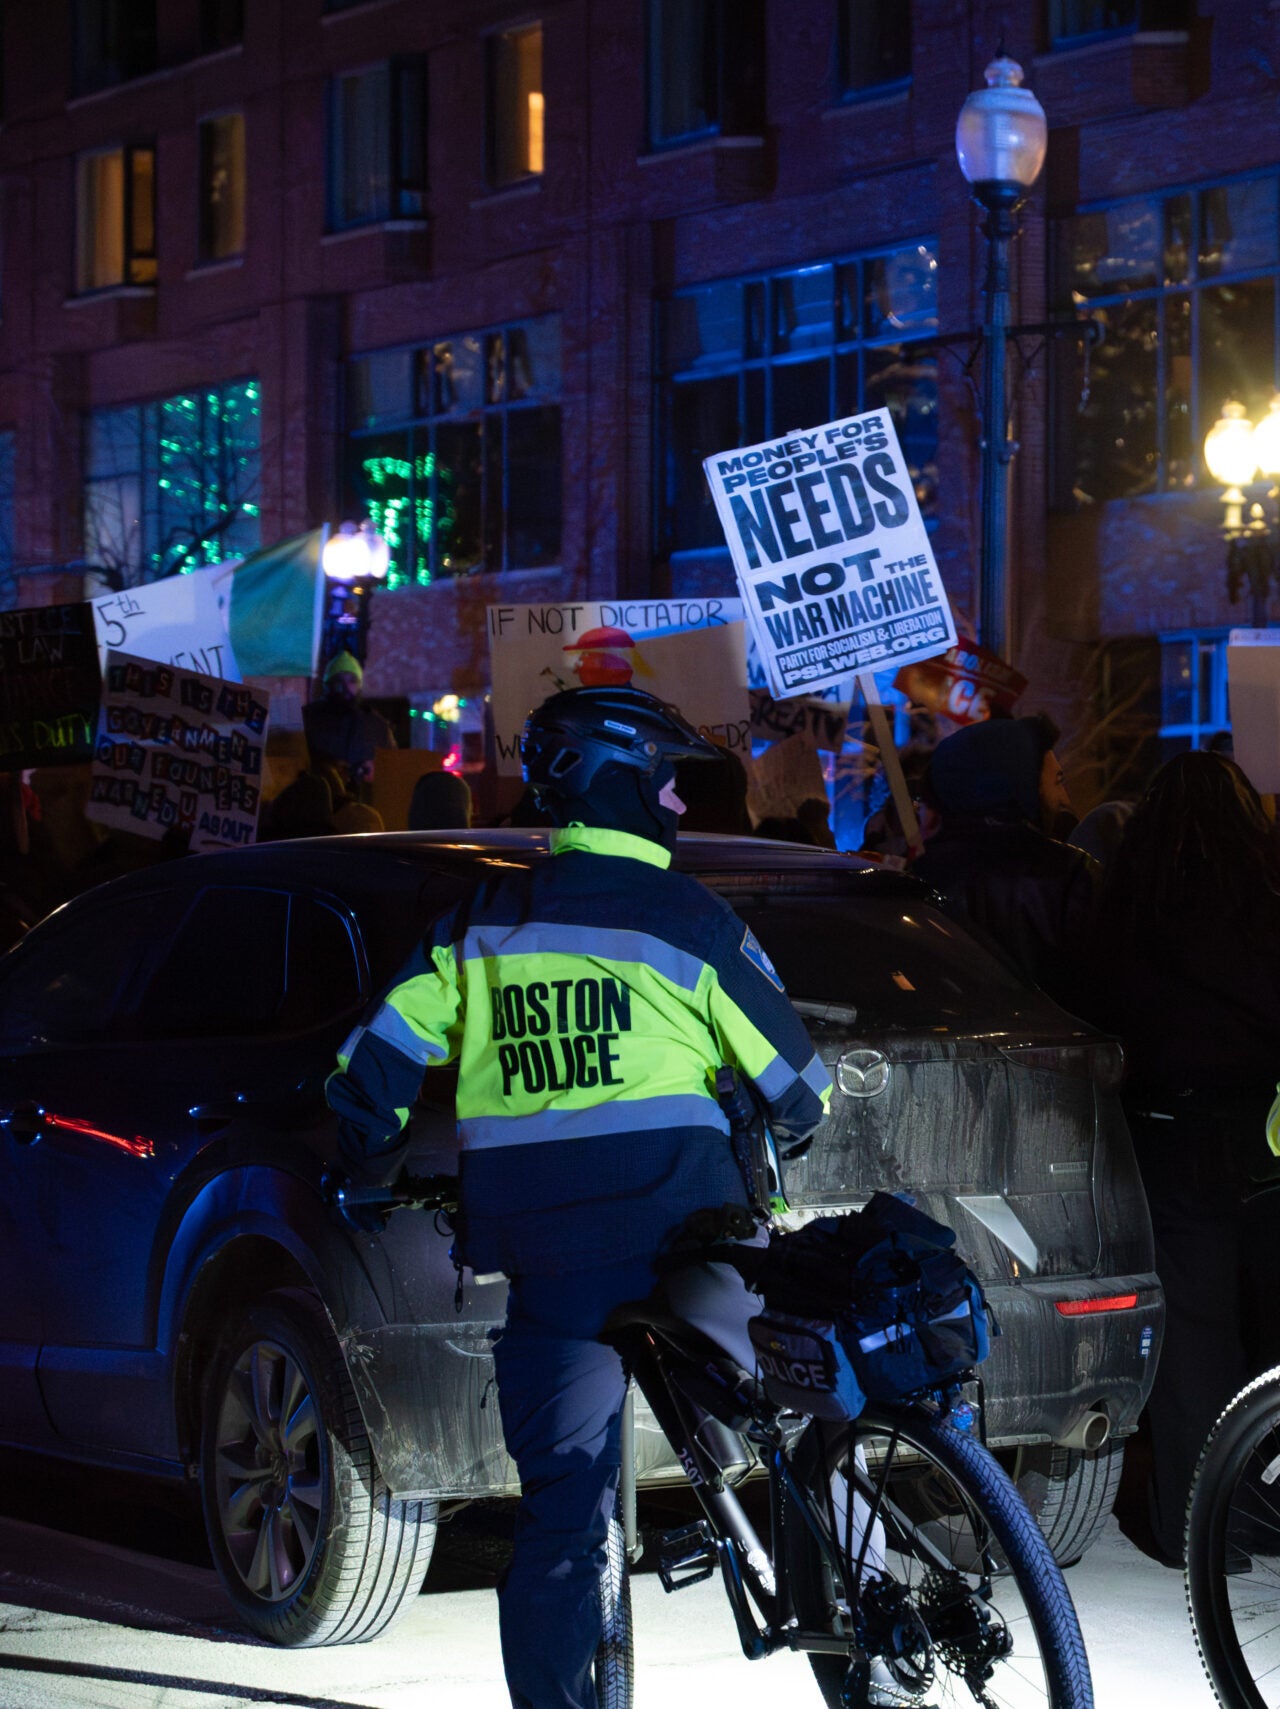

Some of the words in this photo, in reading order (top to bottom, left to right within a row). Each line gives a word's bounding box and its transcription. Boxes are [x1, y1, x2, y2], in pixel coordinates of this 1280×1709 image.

[717, 434, 819, 476] MONEY
[825, 416, 885, 444] FOR
[722, 432, 889, 494] PEOPLE'S
[729, 452, 909, 570] NEEDS
[754, 548, 882, 612] NOT
[884, 554, 927, 574] THE
[763, 598, 830, 650] WAR
[825, 568, 939, 634] MACHINE
[490, 608, 515, 635] IF
[528, 607, 584, 634] NOT
[600, 600, 729, 628] DICTATOR
[779, 653, 810, 672] PARTY
[809, 645, 829, 664] FOR
[828, 630, 878, 657] SOCIALISM
[876, 628, 890, 642] &
[888, 609, 943, 640] LIBERATION
[783, 627, 945, 686] PSLWEB.ORG
[32, 711, 92, 751] DUTY
[199, 812, 253, 843] ABOUT
[491, 977, 632, 1041] BOSTON
[497, 1033, 624, 1096] POLICE
[756, 1350, 832, 1392] OLICE
